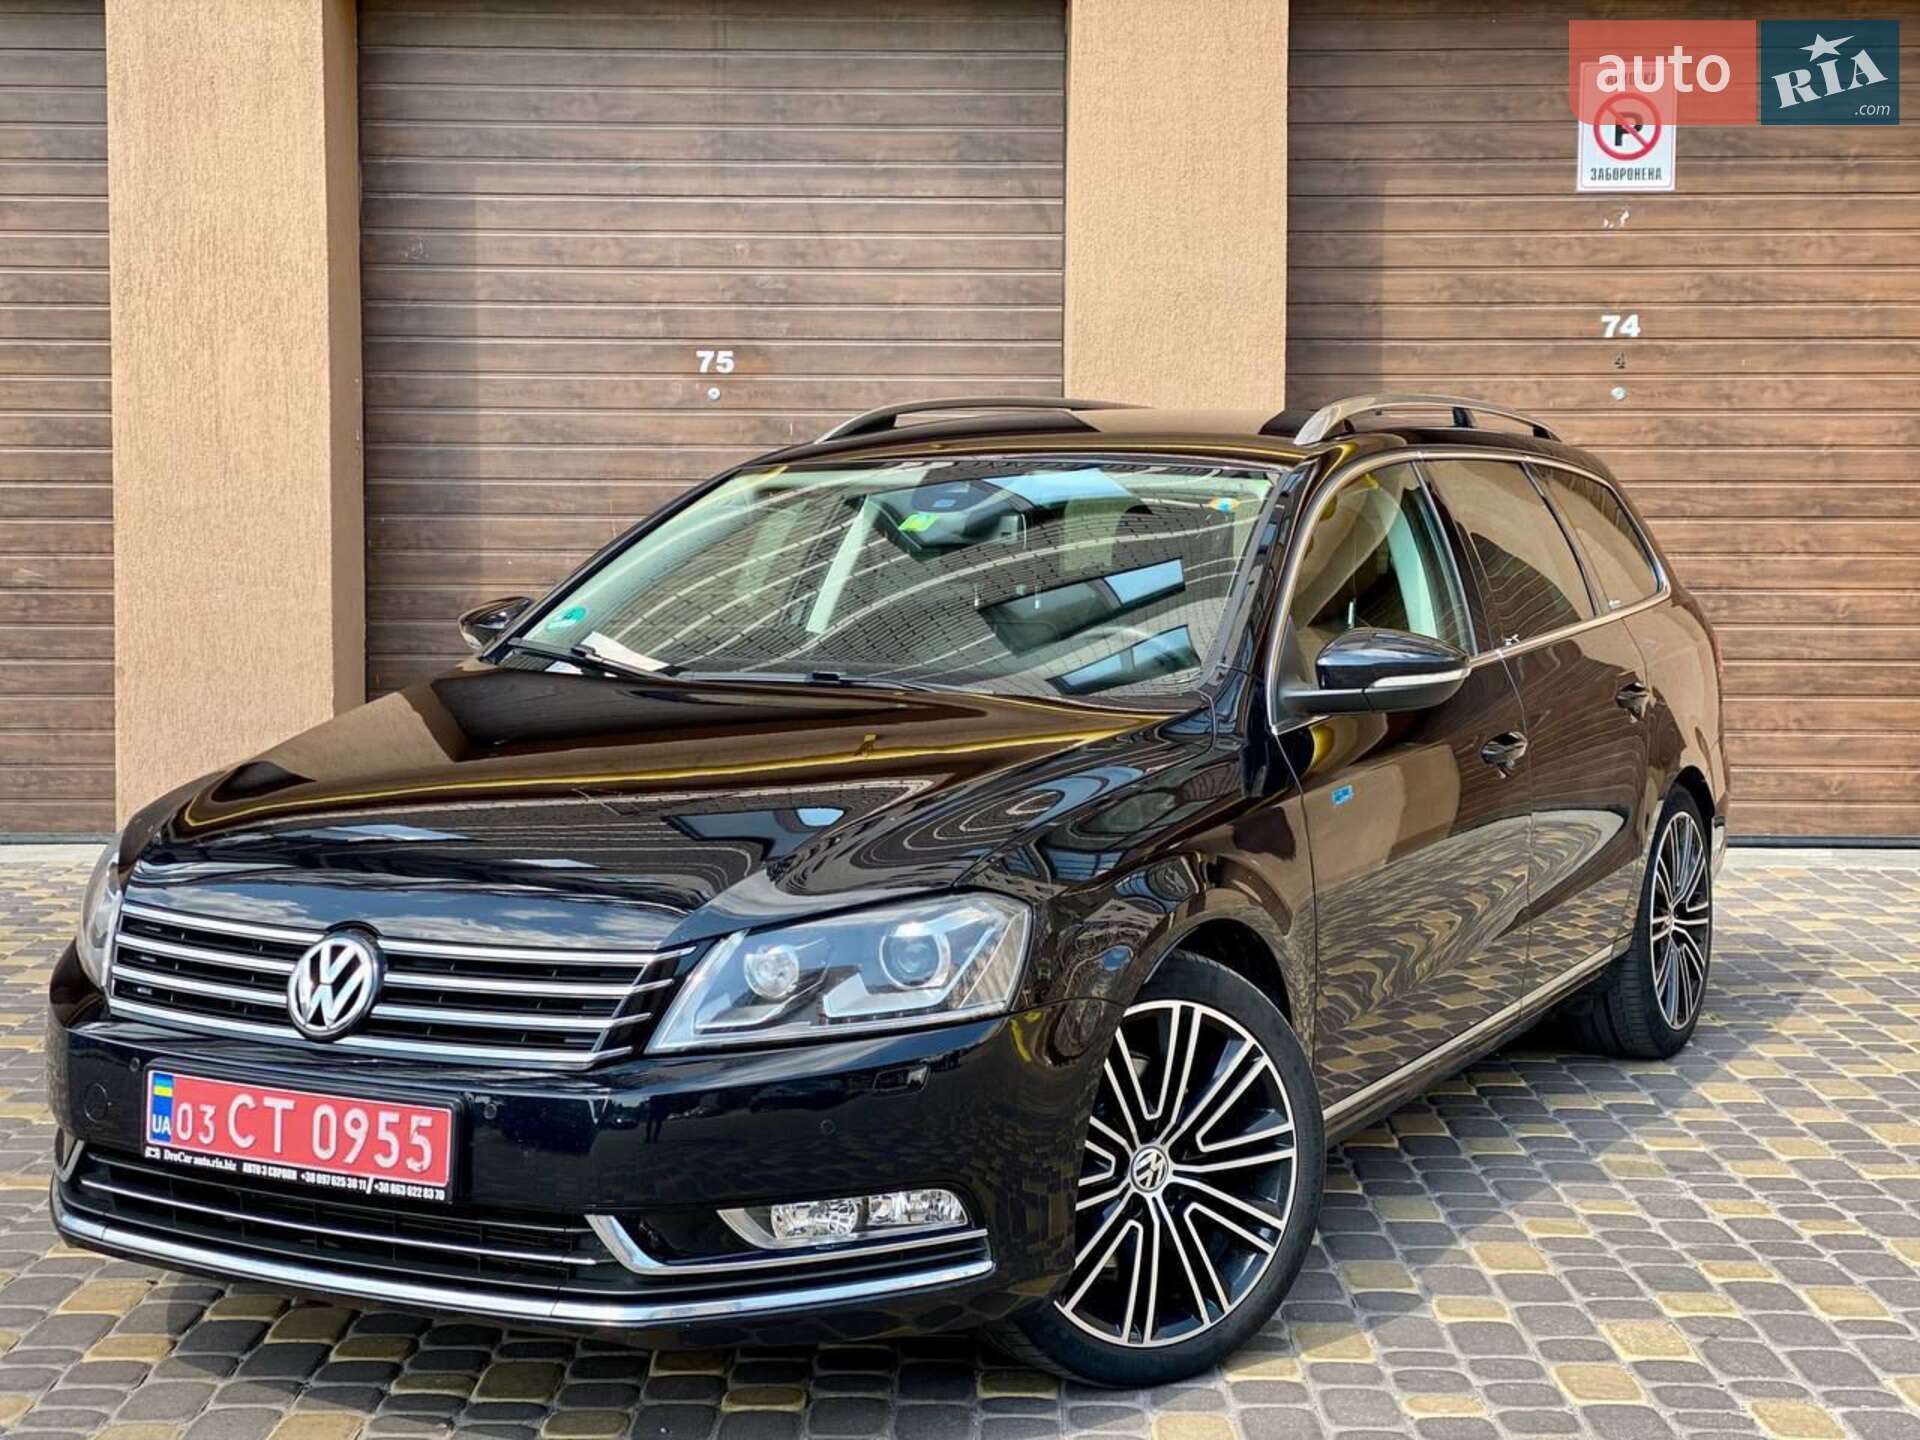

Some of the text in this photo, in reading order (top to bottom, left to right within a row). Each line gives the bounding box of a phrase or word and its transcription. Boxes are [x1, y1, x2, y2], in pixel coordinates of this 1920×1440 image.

[1590, 167, 1662, 182] ЗАБОРОНЕНА
[1601, 314, 1641, 338] 74
[696, 350, 735, 373] 75
[291, 938, 370, 1029] VW
[152, 1093, 432, 1172] UA 03 CT 0955
